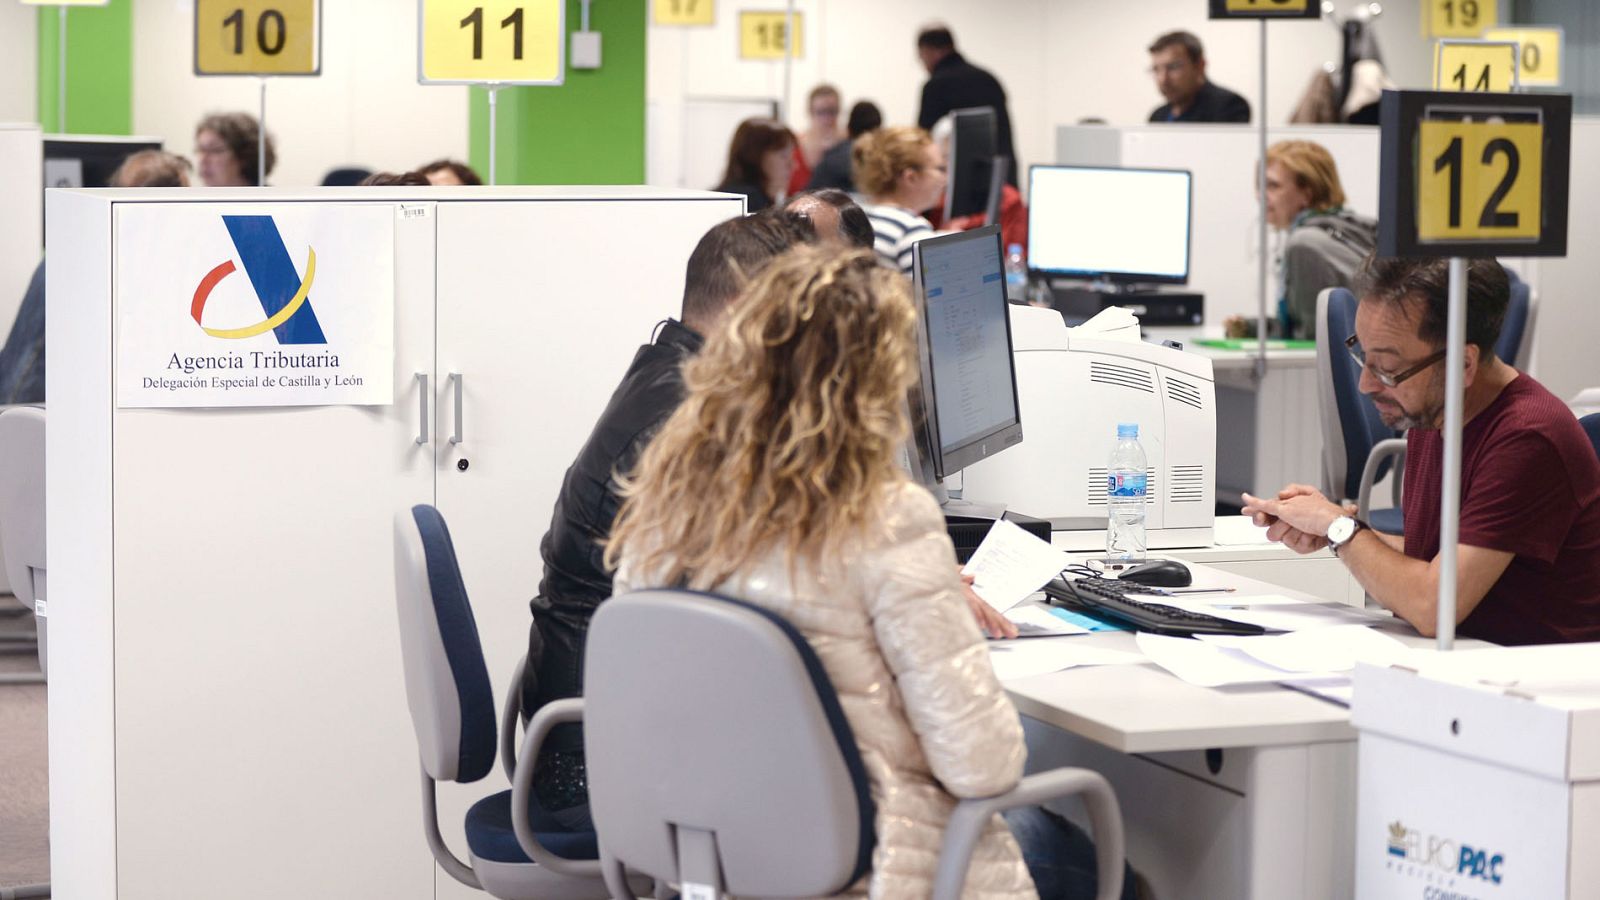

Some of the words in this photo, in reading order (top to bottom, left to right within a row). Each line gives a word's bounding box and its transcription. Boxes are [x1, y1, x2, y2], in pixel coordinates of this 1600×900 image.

[222, 8, 286, 56] 10
[1441, 0, 1479, 27] 19
[459, 7, 524, 60] 11
[1434, 136, 1520, 228] 12
[167, 351, 244, 374] Agencia
[249, 350, 341, 370] Tributaria
[142, 376, 208, 391] Delegación
[211, 376, 259, 391] Especial
[262, 375, 276, 387] de
[278, 375, 321, 387] Castilla
[323, 378, 331, 389] y
[334, 374, 364, 387] León
